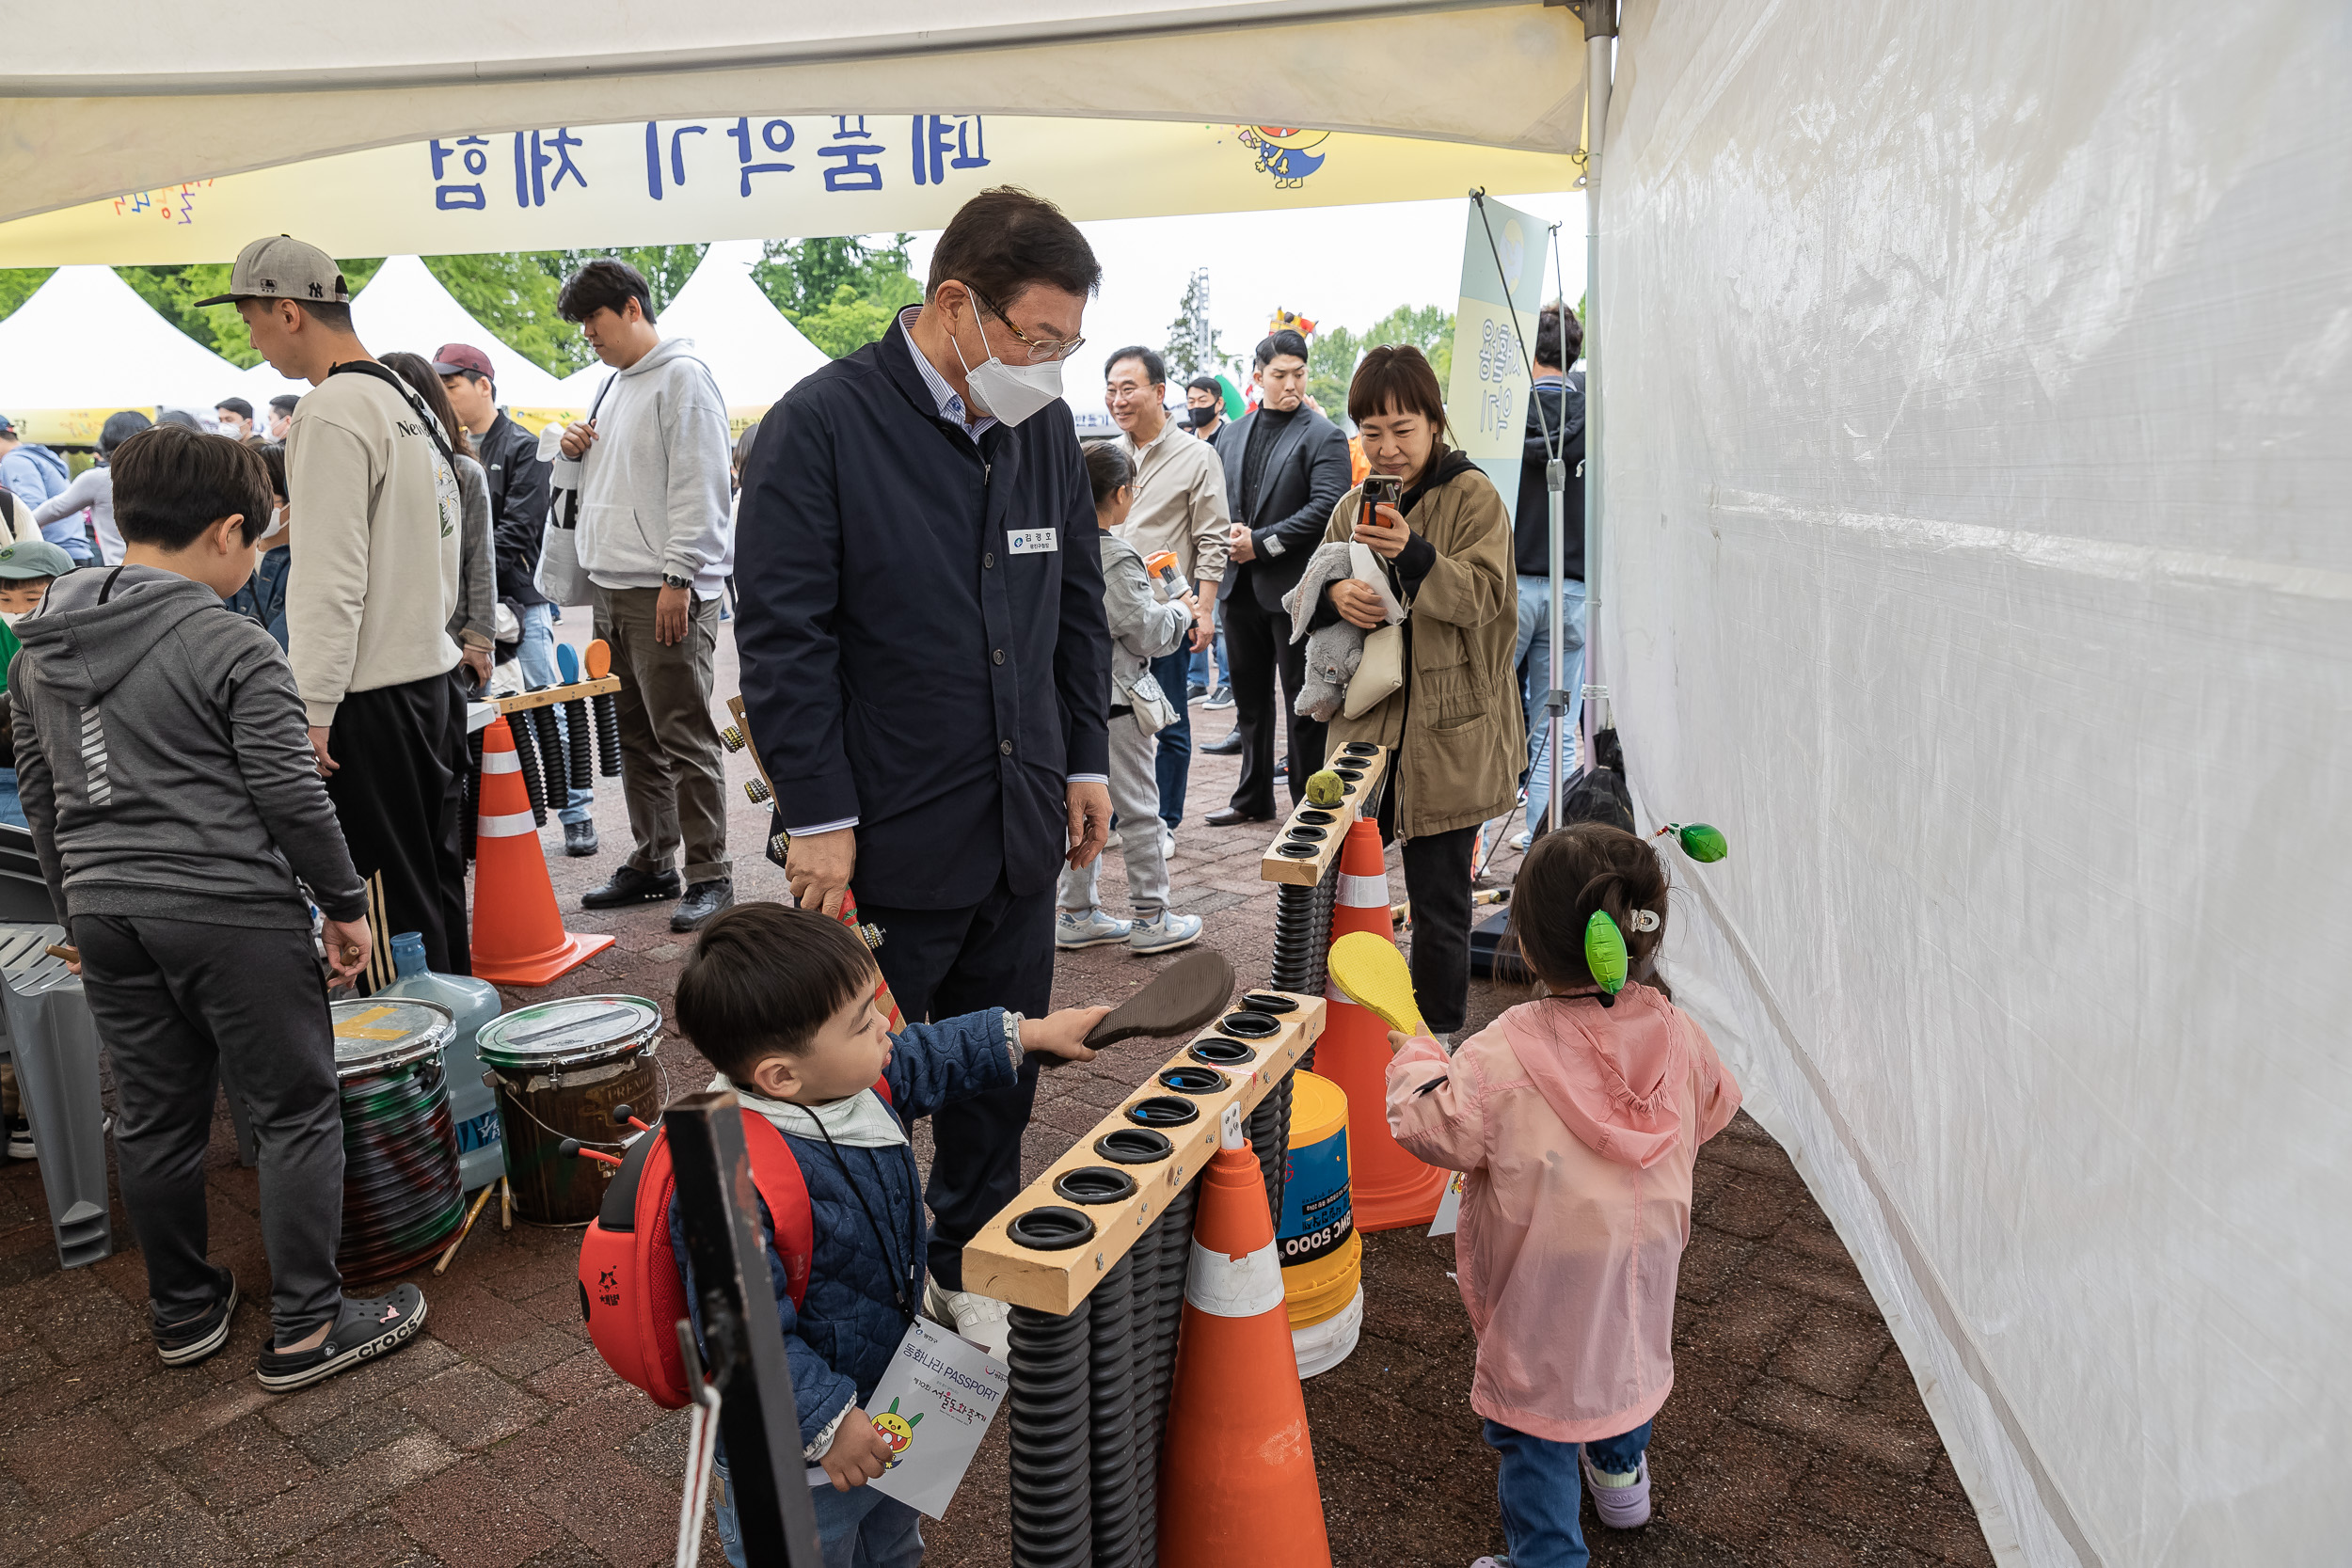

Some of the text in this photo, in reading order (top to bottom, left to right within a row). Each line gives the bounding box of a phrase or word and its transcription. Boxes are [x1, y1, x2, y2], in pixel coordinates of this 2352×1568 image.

[1286, 1227, 1331, 1256] 5000
[358, 1319, 418, 1358] crocs
[903, 1342, 944, 1374] 동화나라
[944, 1366, 999, 1402] PASSPORT
